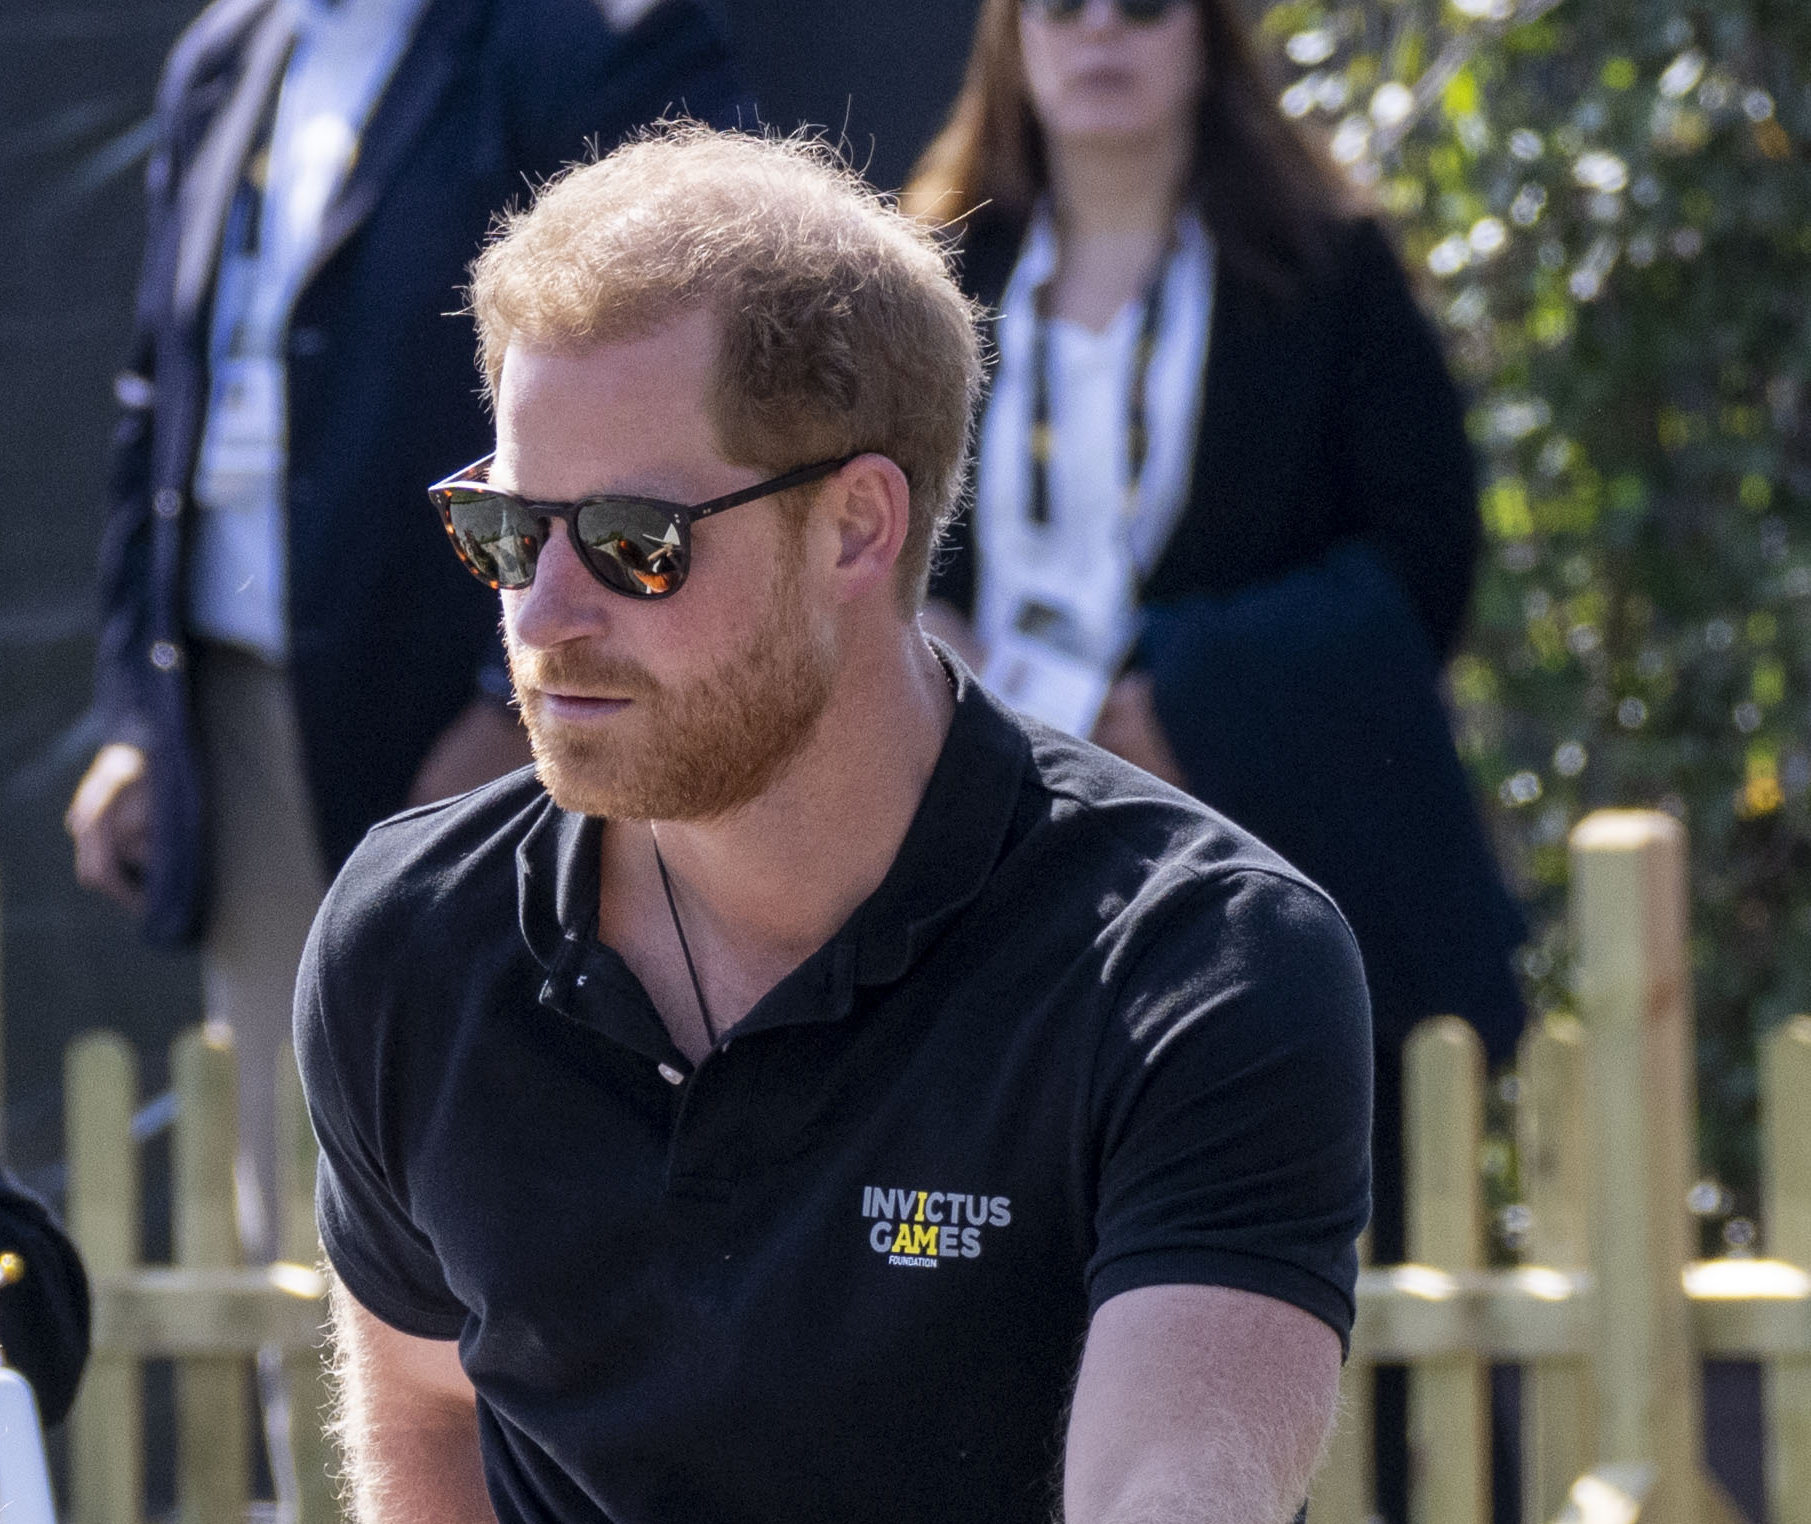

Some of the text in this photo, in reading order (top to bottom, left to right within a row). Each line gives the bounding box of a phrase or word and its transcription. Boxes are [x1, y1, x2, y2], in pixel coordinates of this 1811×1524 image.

[862, 1186, 1012, 1227] INVICTUS
[869, 1221, 982, 1259] GAMES
[888, 1255, 938, 1268] FOUNDATION
